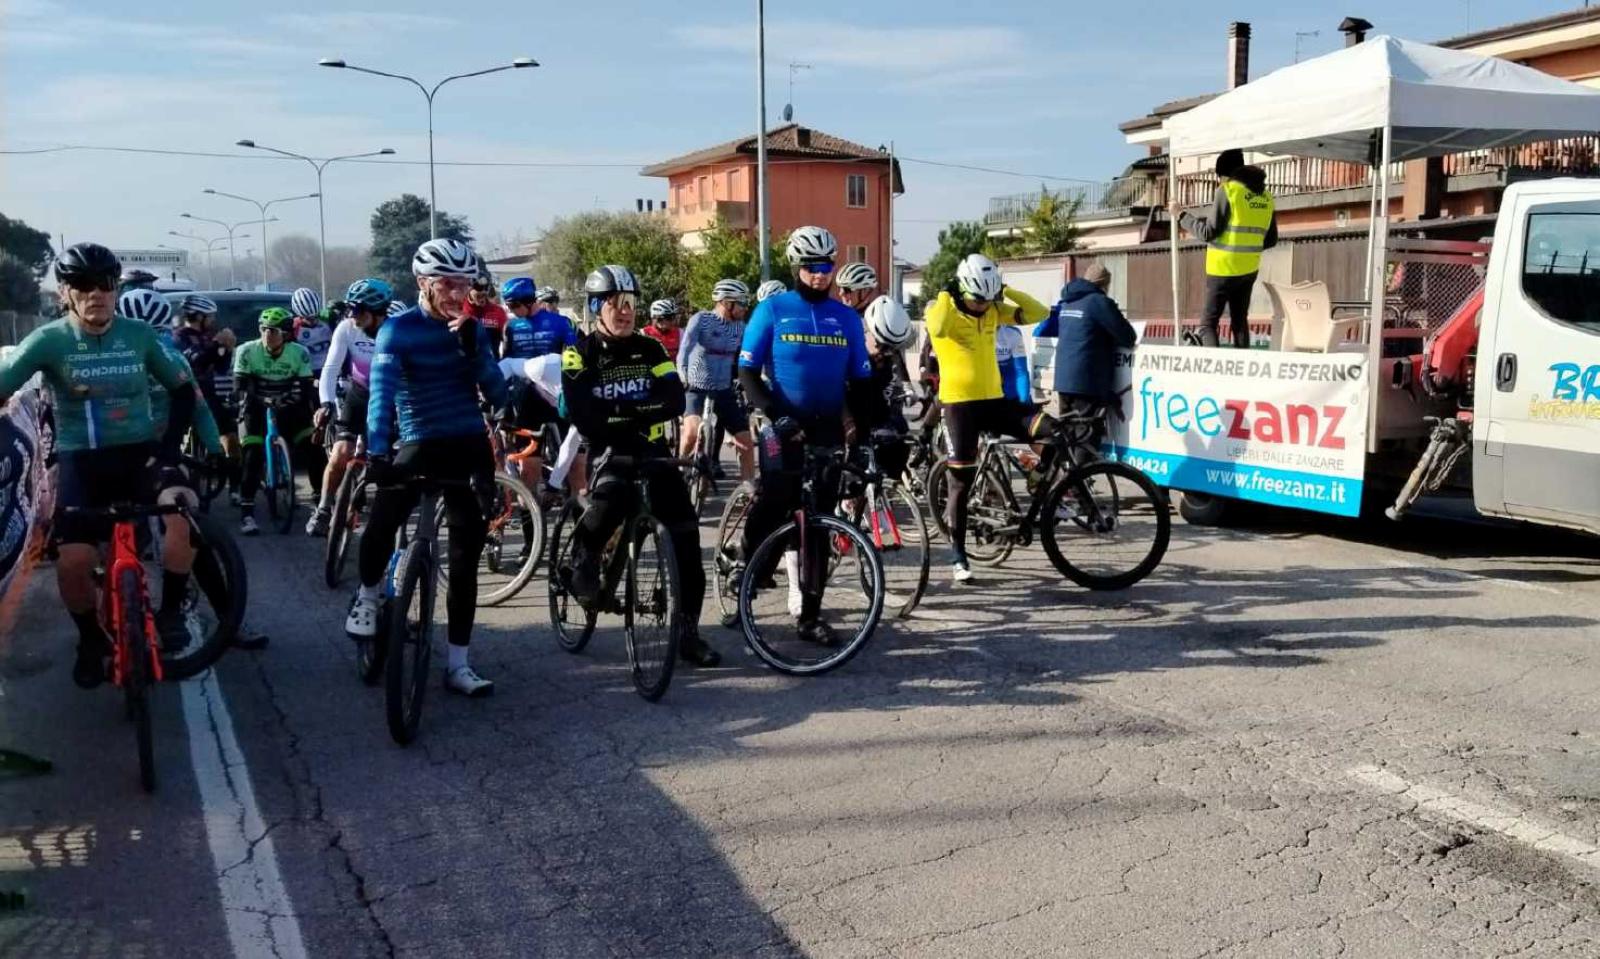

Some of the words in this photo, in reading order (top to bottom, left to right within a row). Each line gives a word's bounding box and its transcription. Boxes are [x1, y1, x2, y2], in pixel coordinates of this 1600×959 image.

[71, 362, 145, 379] FONDRIEST
[1140, 353, 1245, 377] ANTIZANZARE
[1247, 360, 1272, 379] DA
[1277, 362, 1362, 382] ESTERNO
[1140, 376, 1347, 450] freezanz
[1263, 449, 1293, 464] DALLE
[1296, 452, 1345, 471] ZANZARE
[1206, 468, 1346, 504] www.freezanz.it
